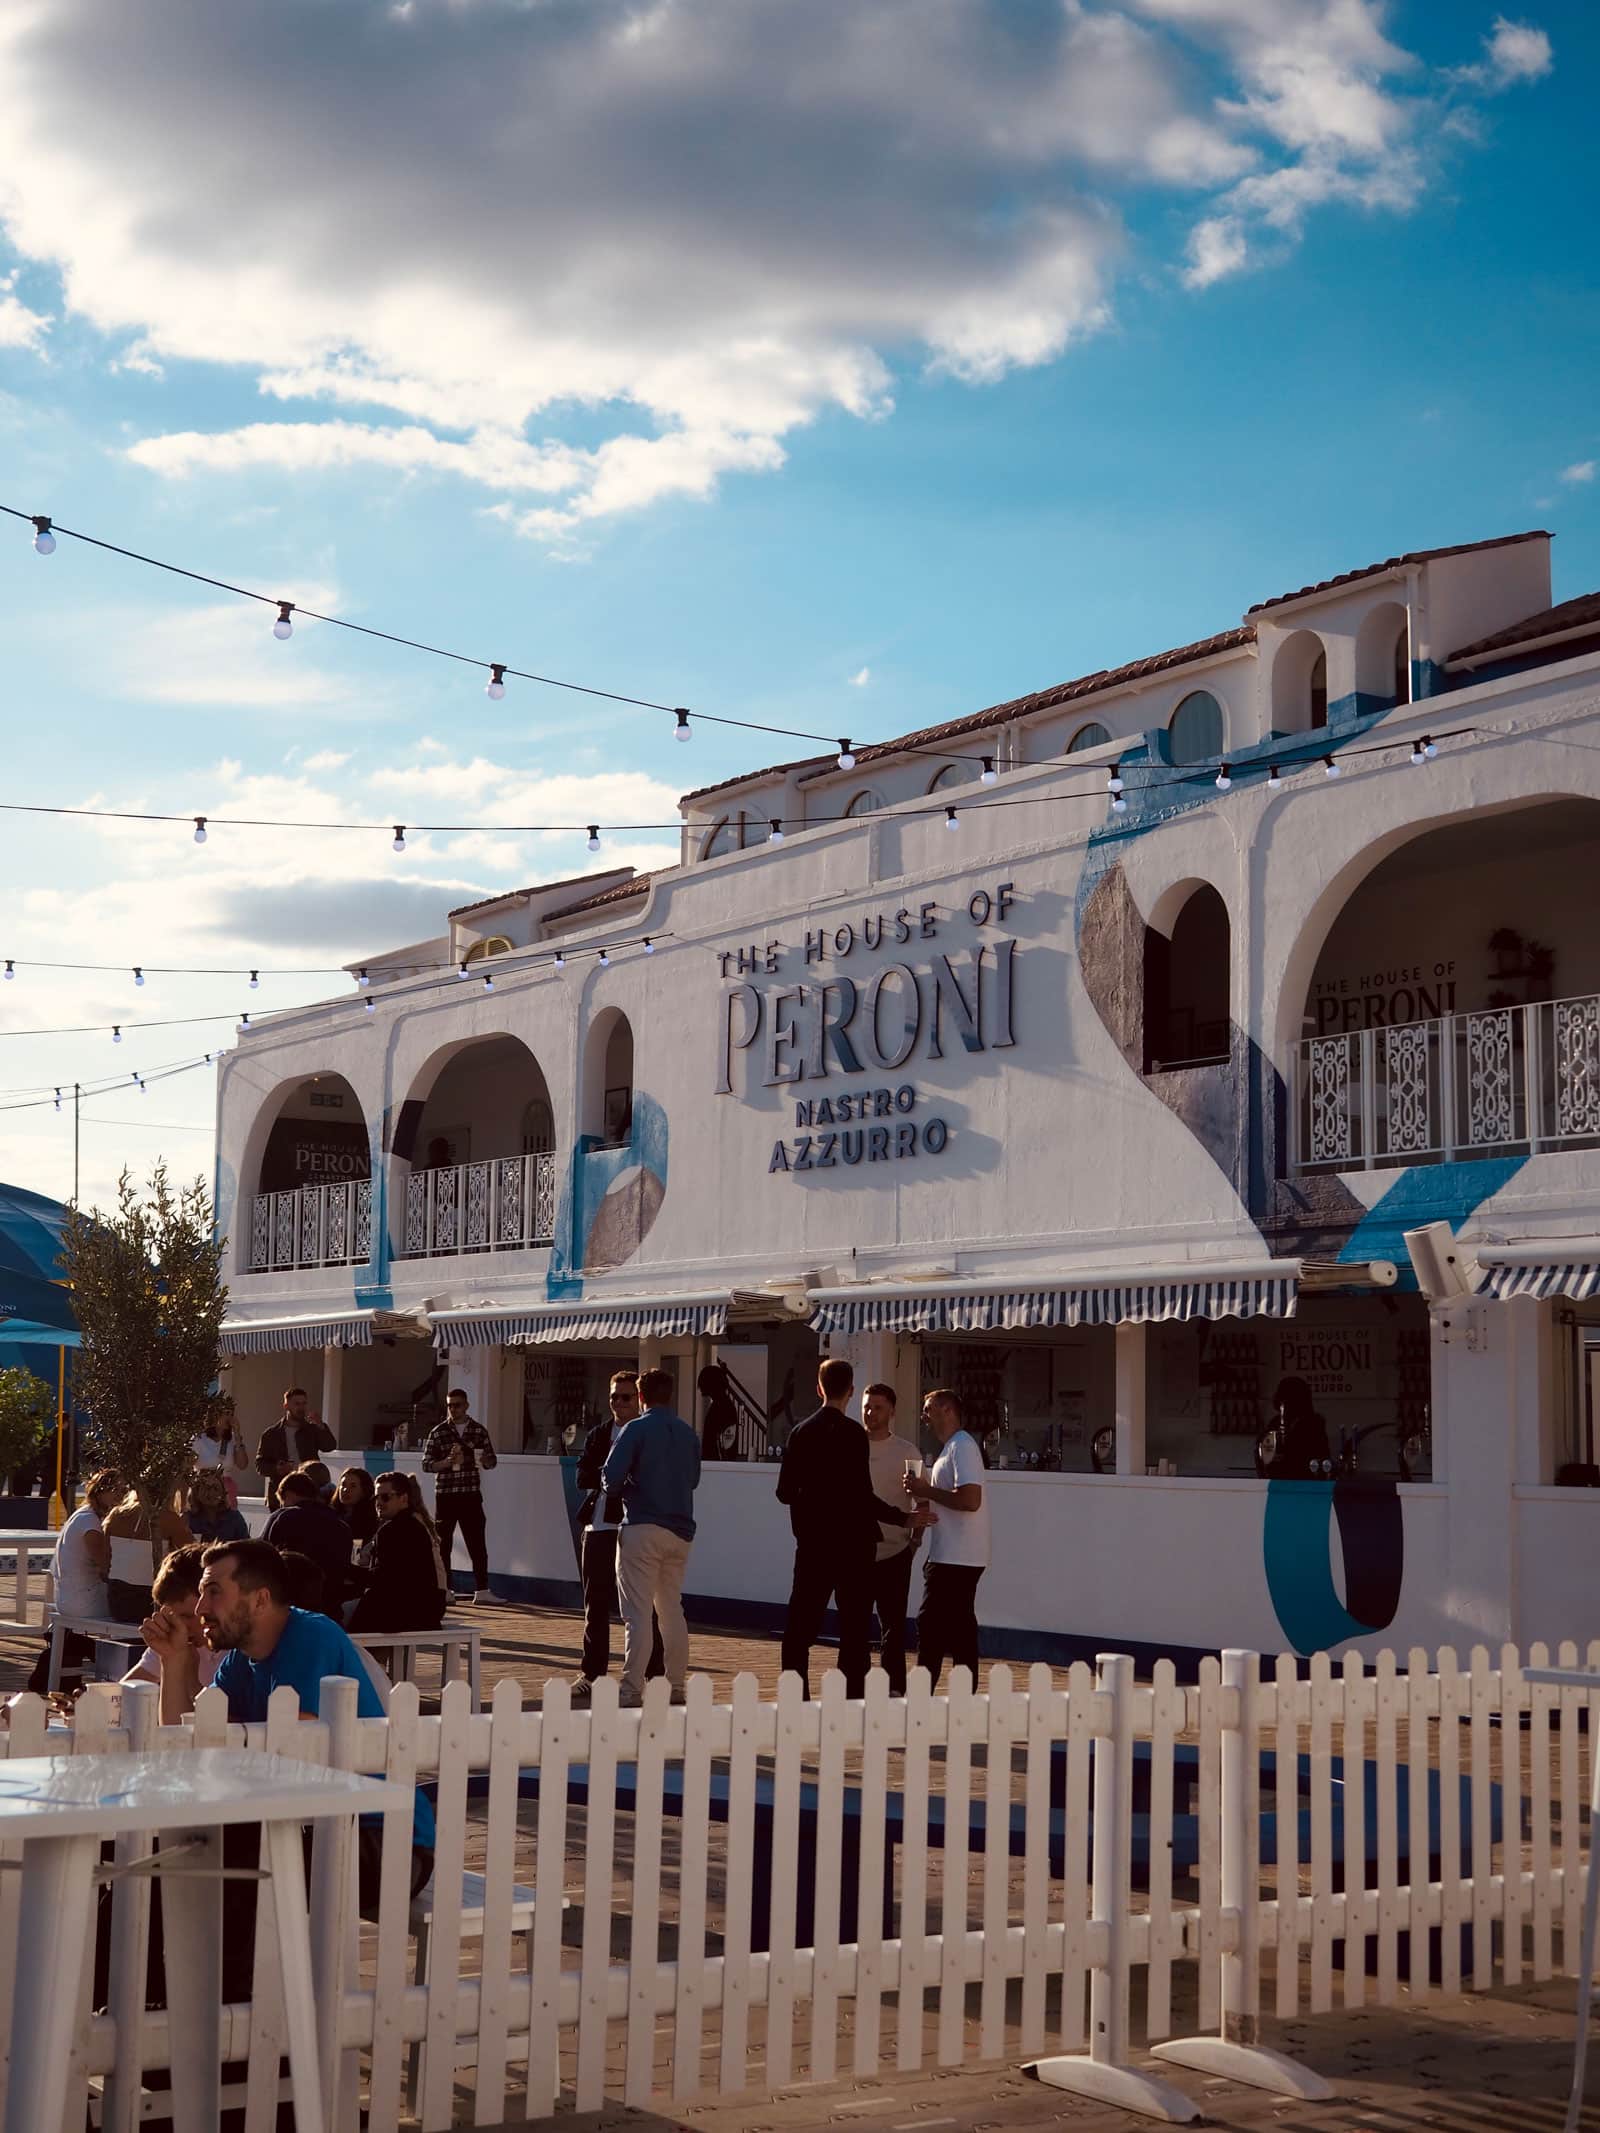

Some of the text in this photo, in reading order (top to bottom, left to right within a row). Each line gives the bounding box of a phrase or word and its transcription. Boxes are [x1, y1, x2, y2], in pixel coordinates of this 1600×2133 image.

[717, 883, 1015, 979] THE HOUSE OF
[1316, 961, 1456, 994] THE HOUSE OF
[714, 939, 1017, 1095] PERONI
[1317, 981, 1457, 1036] PERONI
[796, 1085, 916, 1128] NASTRO
[295, 1149, 370, 1175] PERON
[768, 1118, 948, 1174] AZZURRO
[1280, 1342, 1371, 1370] PERONI
